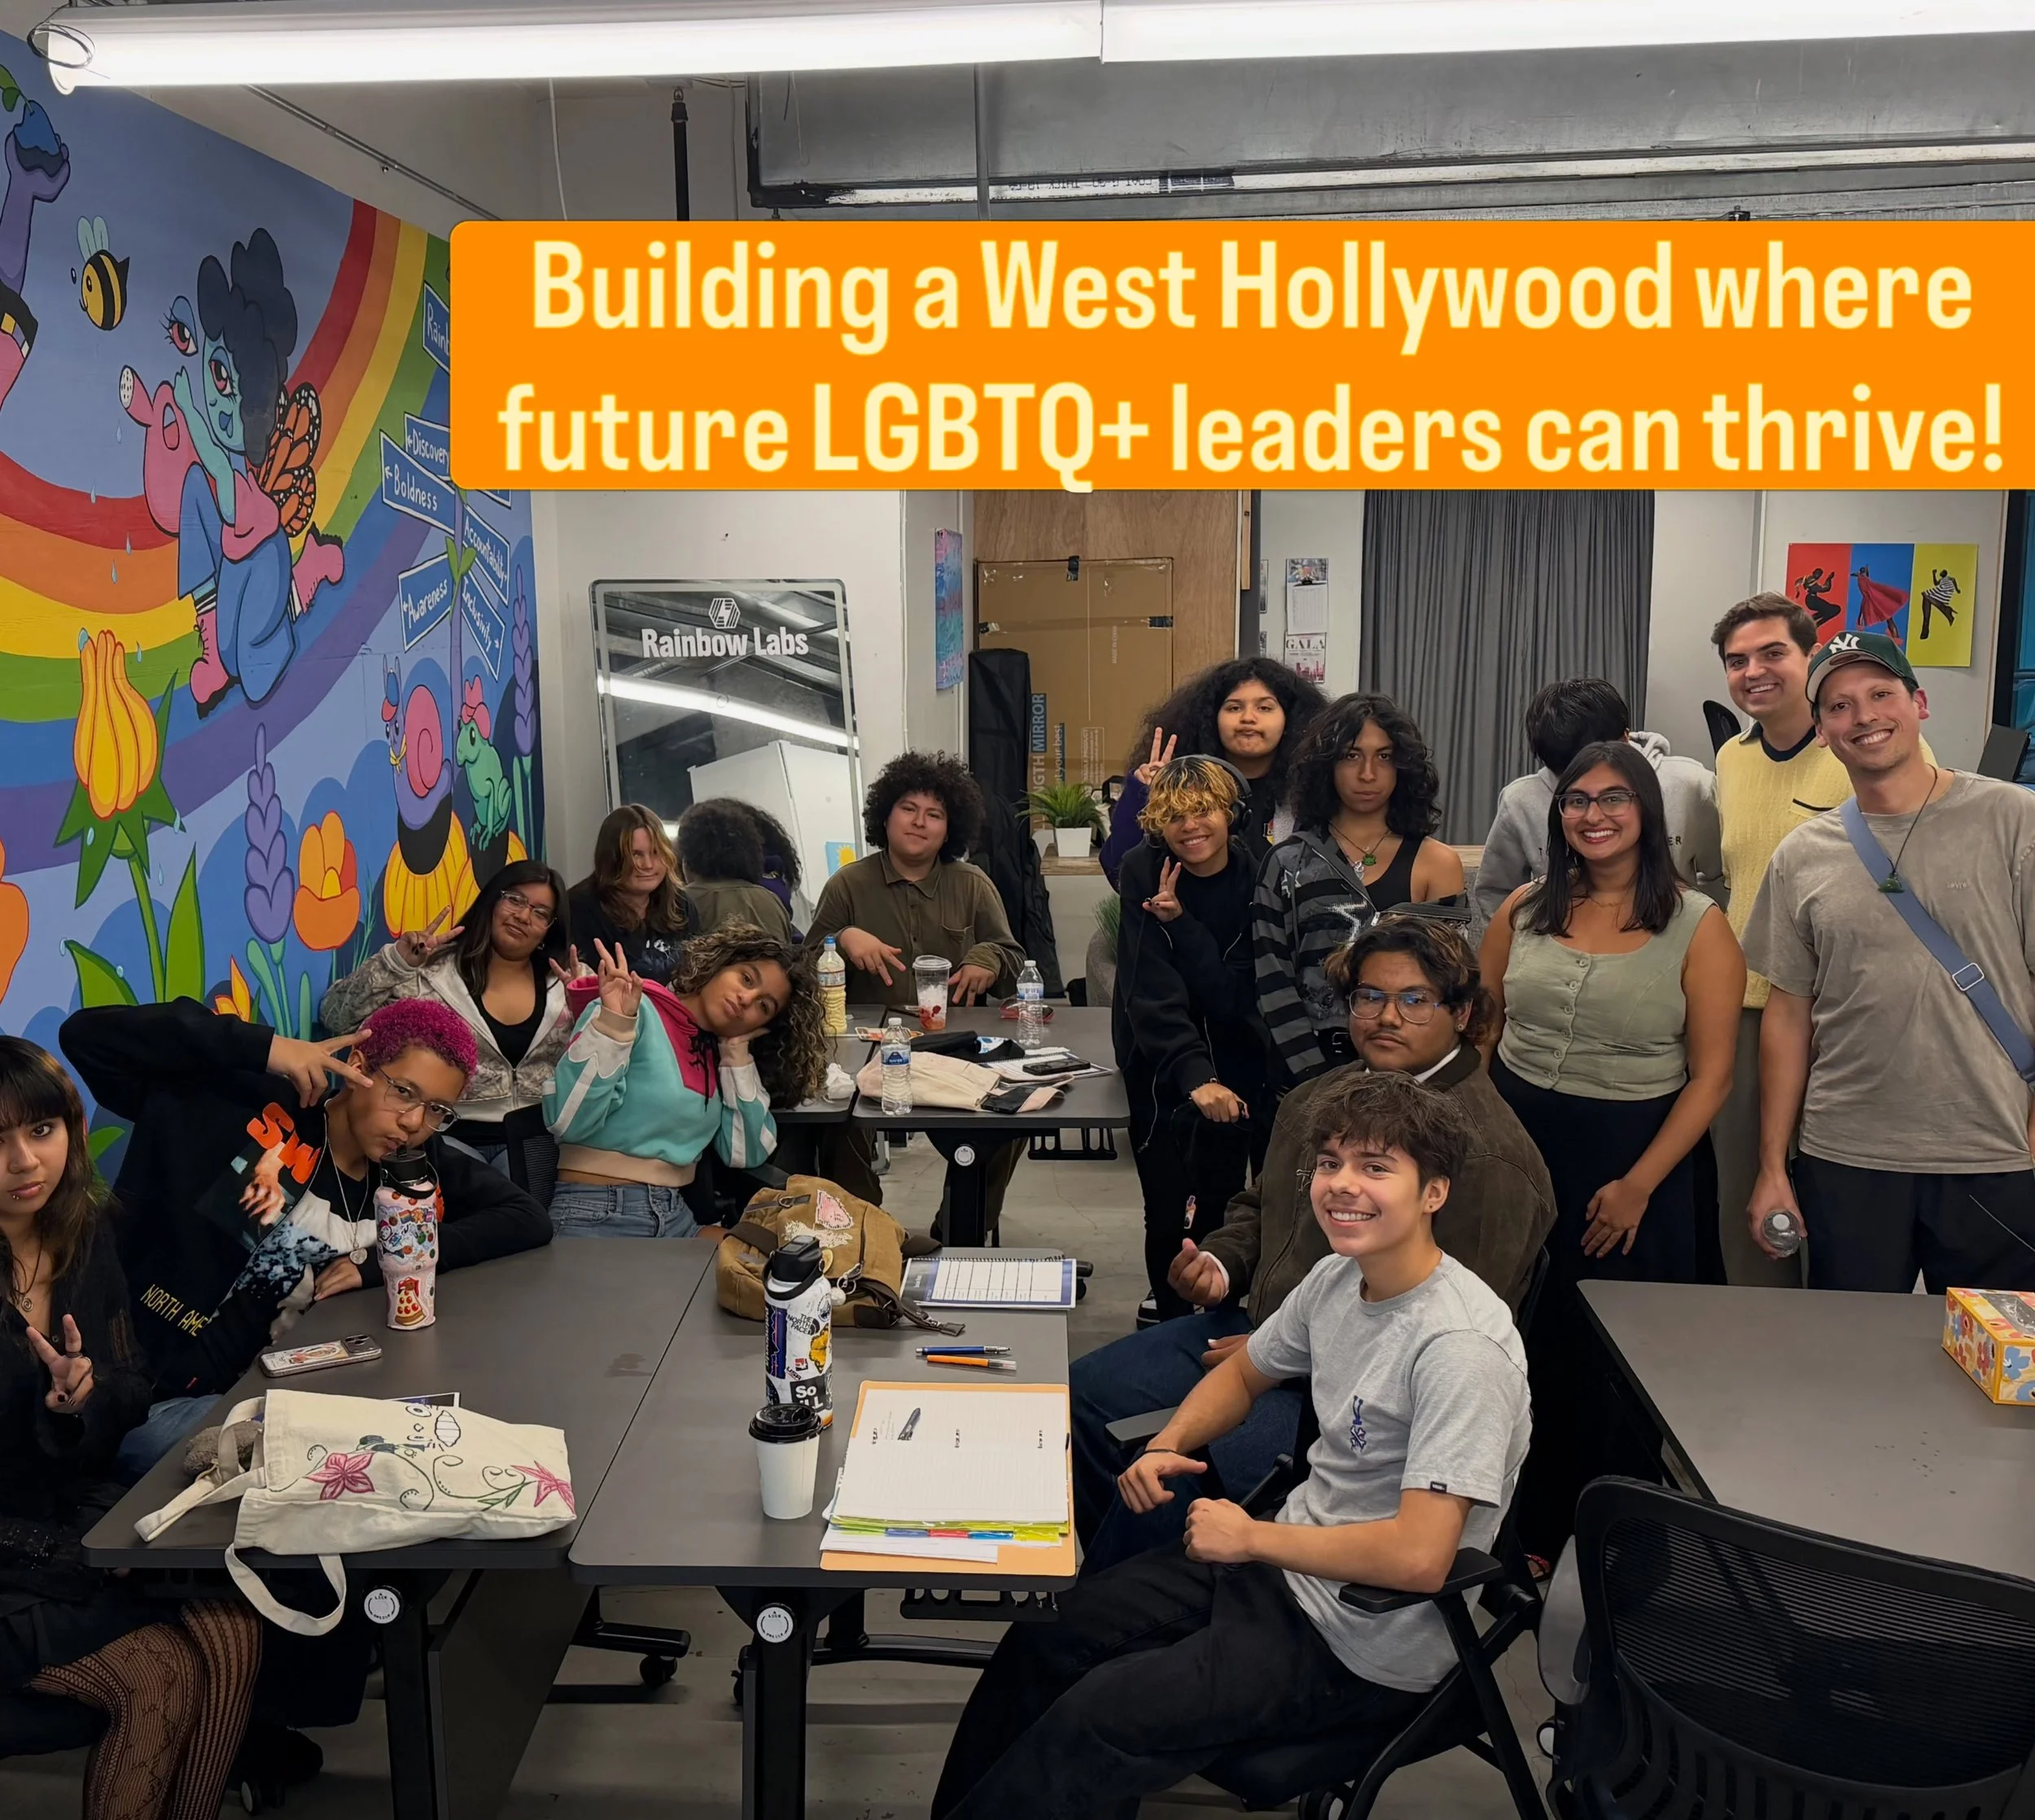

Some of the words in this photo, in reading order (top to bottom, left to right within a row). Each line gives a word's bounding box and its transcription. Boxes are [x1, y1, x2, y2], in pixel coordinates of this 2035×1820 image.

[394, 463, 438, 511] Boldness
[464, 515, 505, 588] Accountability
[408, 579, 449, 629] Awareness
[462, 575, 492, 652] Inclusivity
[641, 628, 749, 658] Rainbow
[753, 626, 810, 655] Labs
[1286, 639, 1325, 650] GALA
[1032, 693, 1045, 752] MIRROR
[1053, 724, 1063, 746] best
[1053, 748, 1066, 772] your
[140, 1284, 184, 1321] NORTH
[787, 1314, 812, 1329] NORTH
